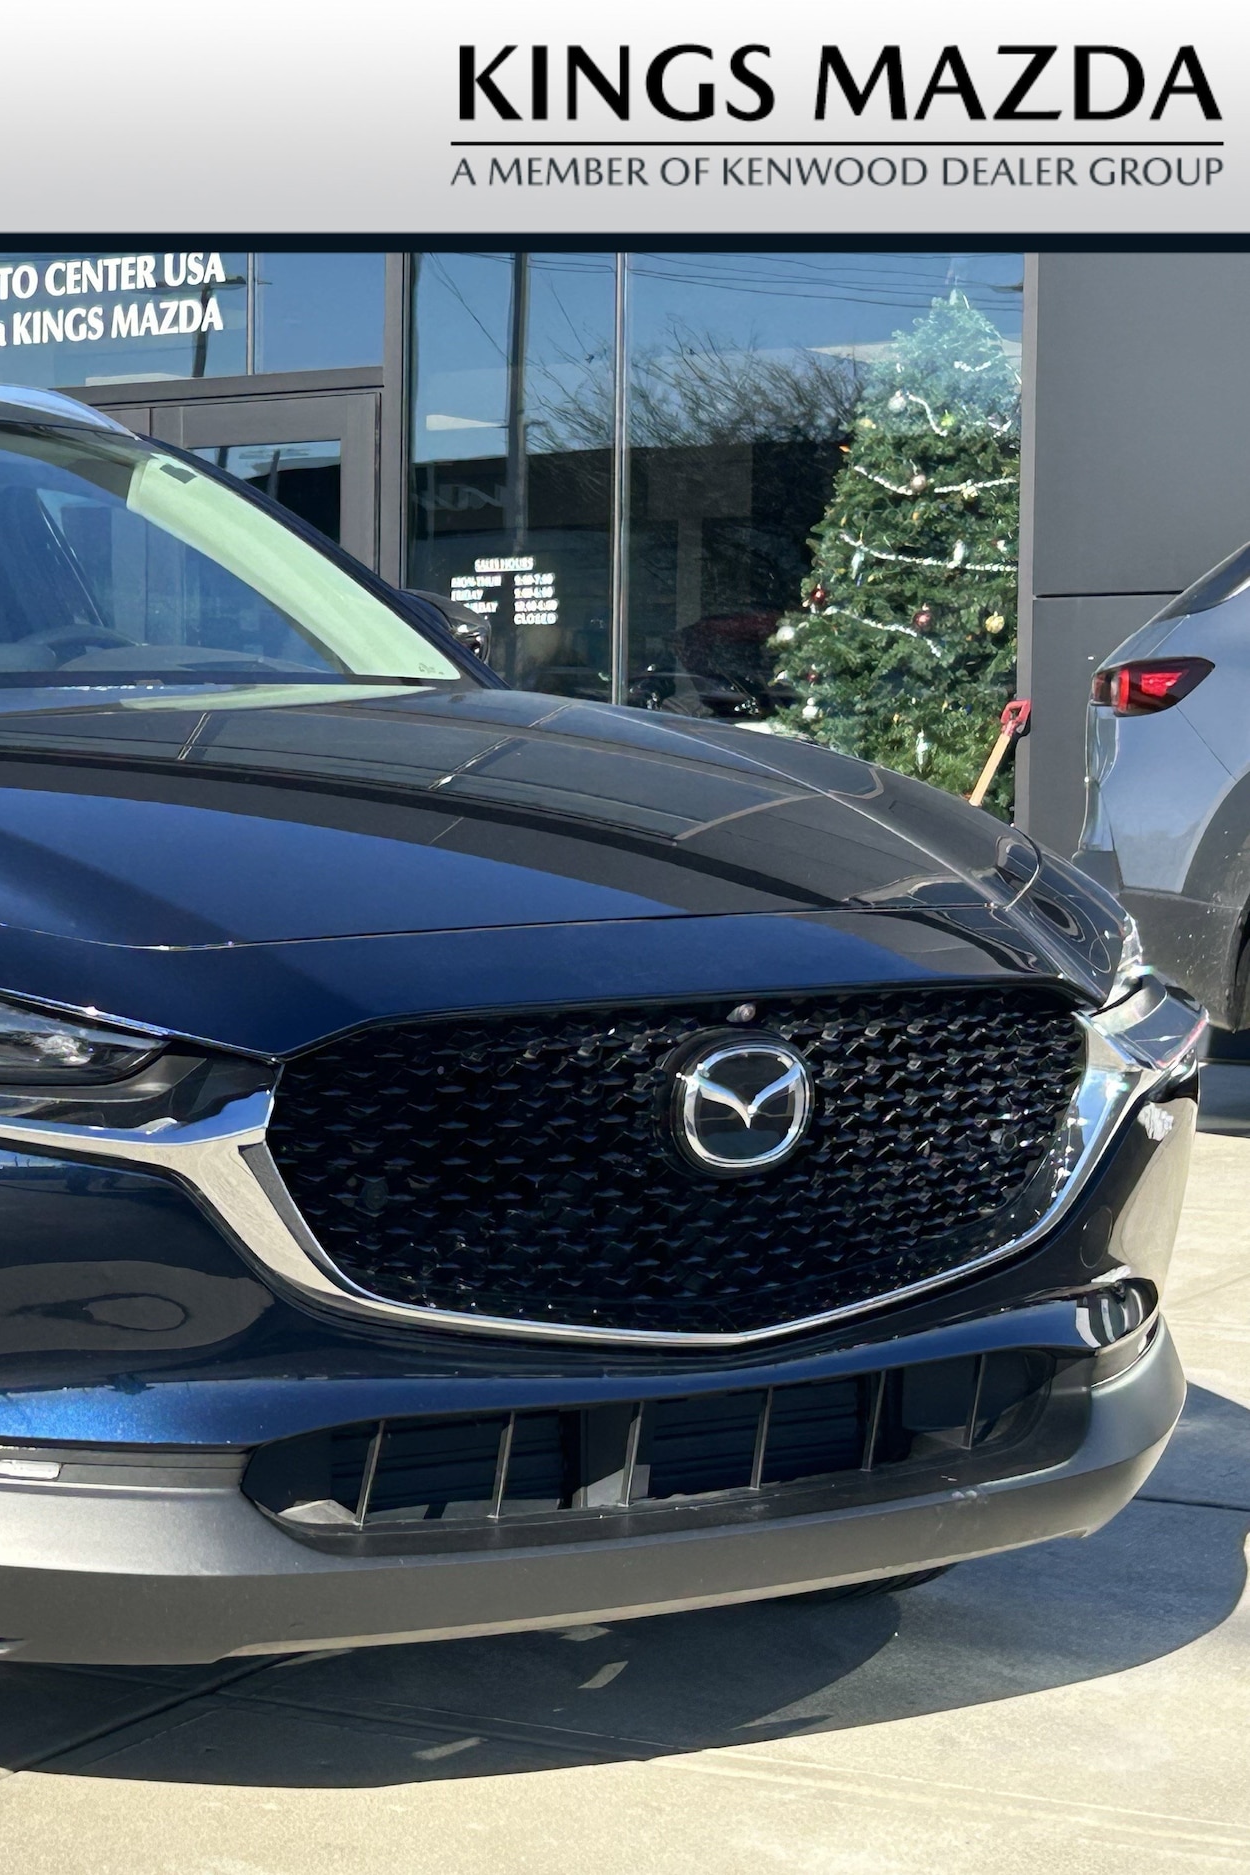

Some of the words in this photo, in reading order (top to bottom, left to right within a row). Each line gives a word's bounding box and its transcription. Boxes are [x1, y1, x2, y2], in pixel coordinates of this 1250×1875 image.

[45, 254, 156, 297] CENTER
[163, 252, 226, 287] USA
[12, 306, 104, 346] KINGS
[110, 297, 224, 338] MAZDA
[514, 612, 558, 625] CLOSED
